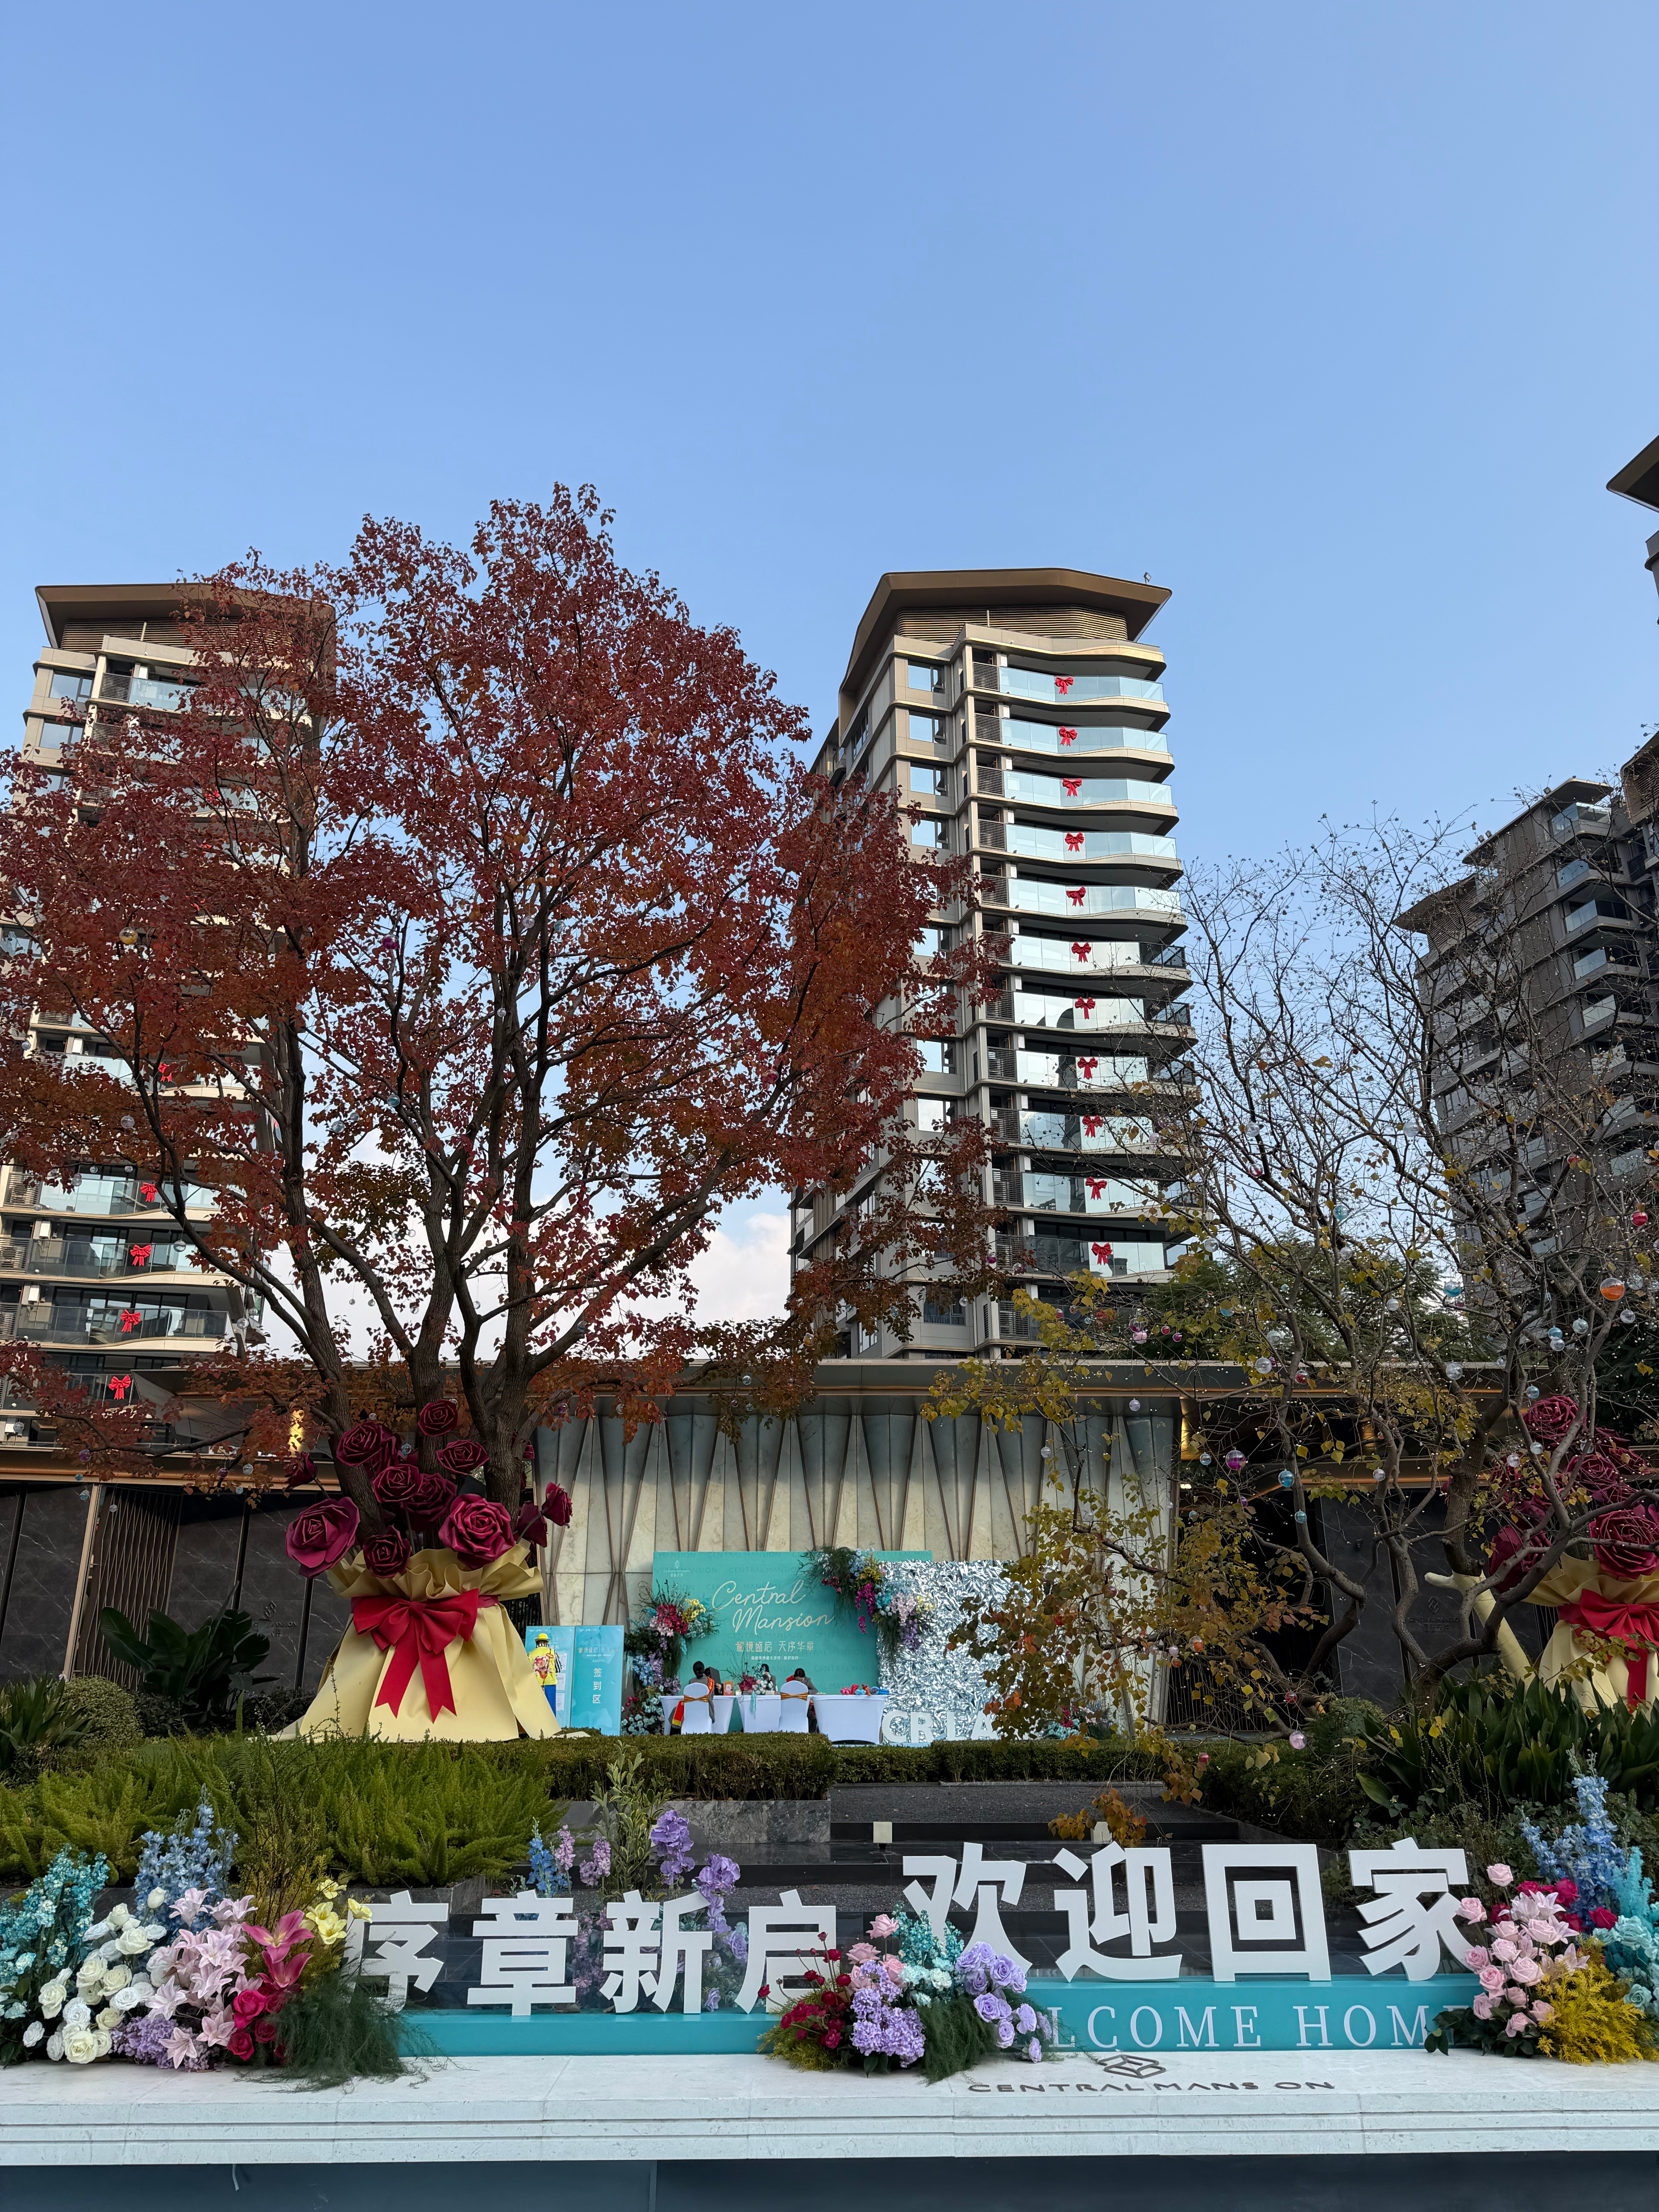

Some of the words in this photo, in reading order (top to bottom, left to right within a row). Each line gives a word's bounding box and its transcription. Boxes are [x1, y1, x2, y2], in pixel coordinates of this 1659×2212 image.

[712, 1580, 806, 1610] Central
[732, 1604, 835, 1635] Mansion
[778, 1640, 814, 1652] 天序华章
[592, 1668, 603, 1704] 签到区
[902, 1837, 1475, 1983] 欢迎回家
[341, 1889, 837, 2017] 序章新启
[1047, 2005, 1261, 2049] LCOME
[969, 2083, 1145, 2093] CENTRAL
